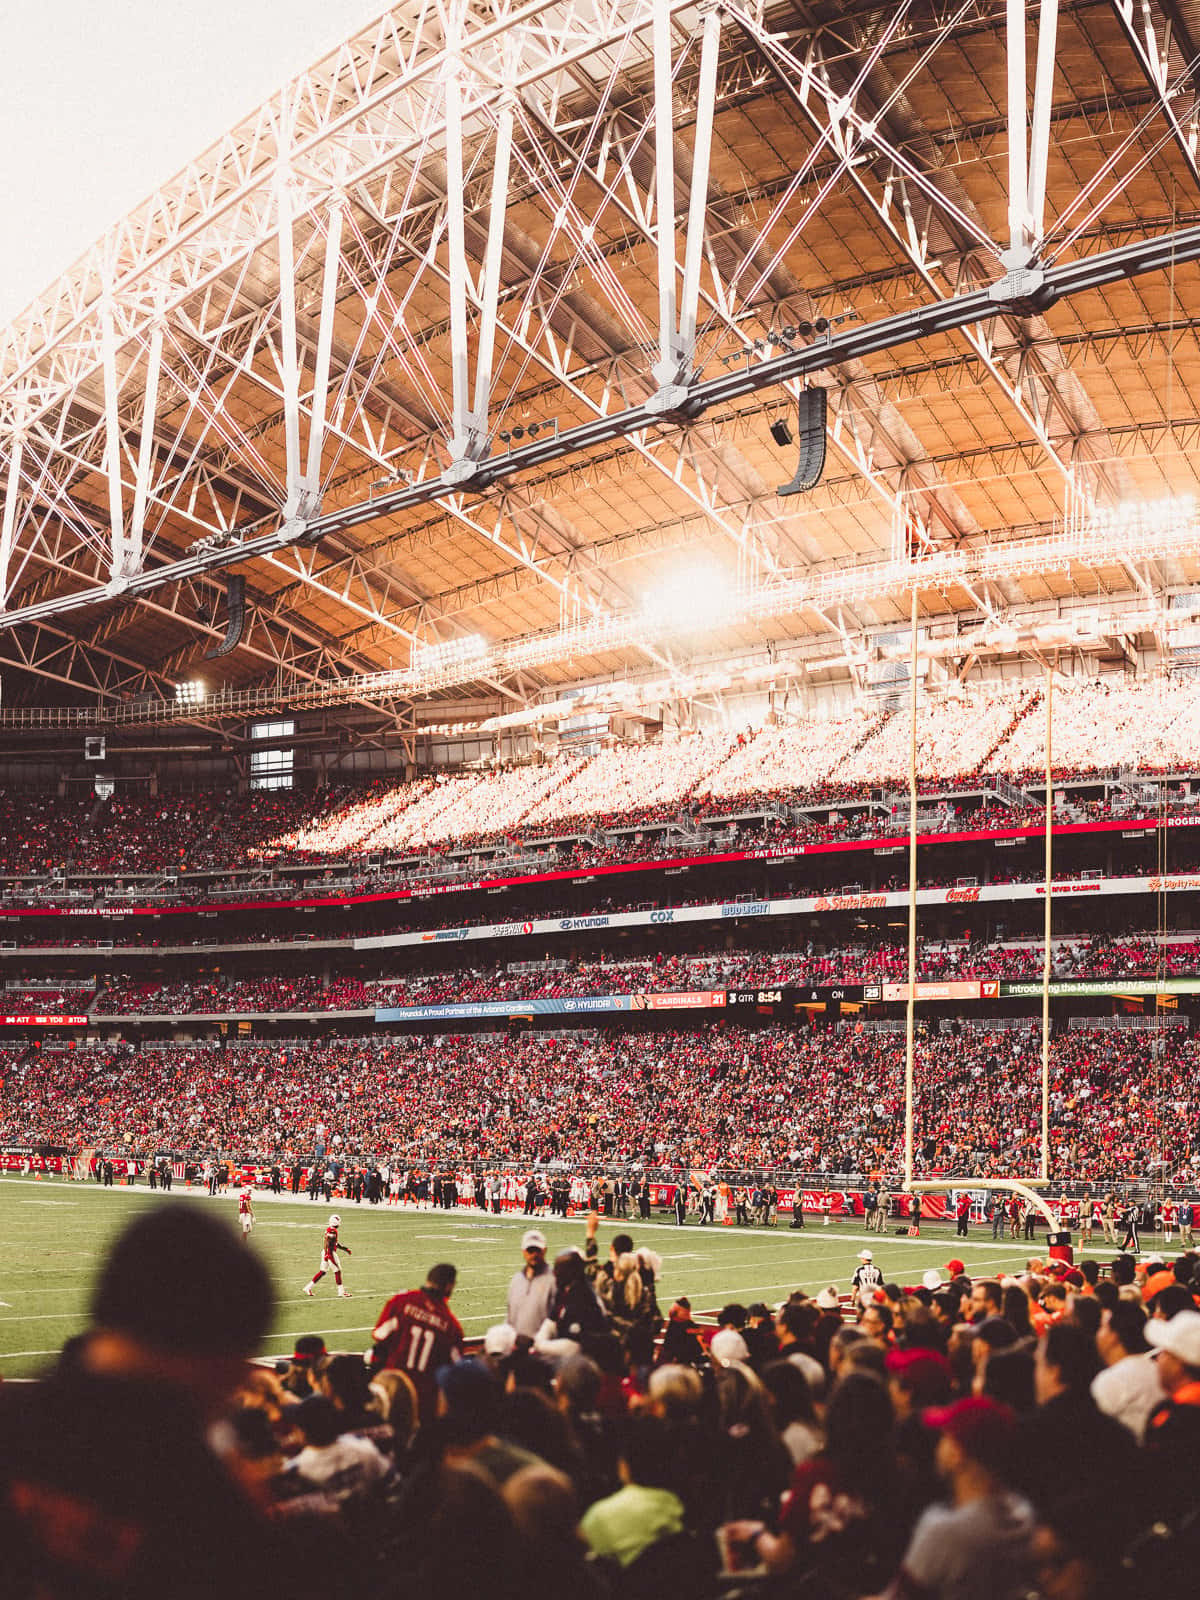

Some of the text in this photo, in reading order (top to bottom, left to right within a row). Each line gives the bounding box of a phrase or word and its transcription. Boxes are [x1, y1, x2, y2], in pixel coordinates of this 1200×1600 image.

[1168, 816, 1200, 826] ROGER
[771, 847, 805, 857] TILLMAN
[1072, 884, 1101, 892] CASINOS
[1164, 879, 1188, 889] Dignity
[410, 887, 436, 896] CHARLES
[722, 903, 768, 916] BUD LIGHT
[573, 917, 609, 929] HYUNDAI
[650, 911, 674, 923] COX
[490, 924, 524, 937] SAFEWAY
[865, 987, 880, 998] 25
[982, 983, 998, 995] 17
[1009, 983, 1060, 994] Introducng
[1061, 983, 1076, 993] the
[1077, 981, 1116, 994] Hyundai
[1117, 981, 1137, 992] SUV
[578, 1000, 611, 1009] HYUNDAI
[656, 996, 702, 1006] CARDINALS
[712, 994, 724, 1005] 21
[729, 992, 737, 1004] 3
[738, 994, 754, 1003] QTR
[757, 991, 782, 1003] 8:54
[831, 991, 844, 999] ON
[428, 1009, 445, 1017] Proud
[445, 1008, 465, 1016] Partner
[472, 1007, 482, 1015] the
[483, 1005, 505, 1013] Arizona
[407, 1325, 434, 1372] 11
